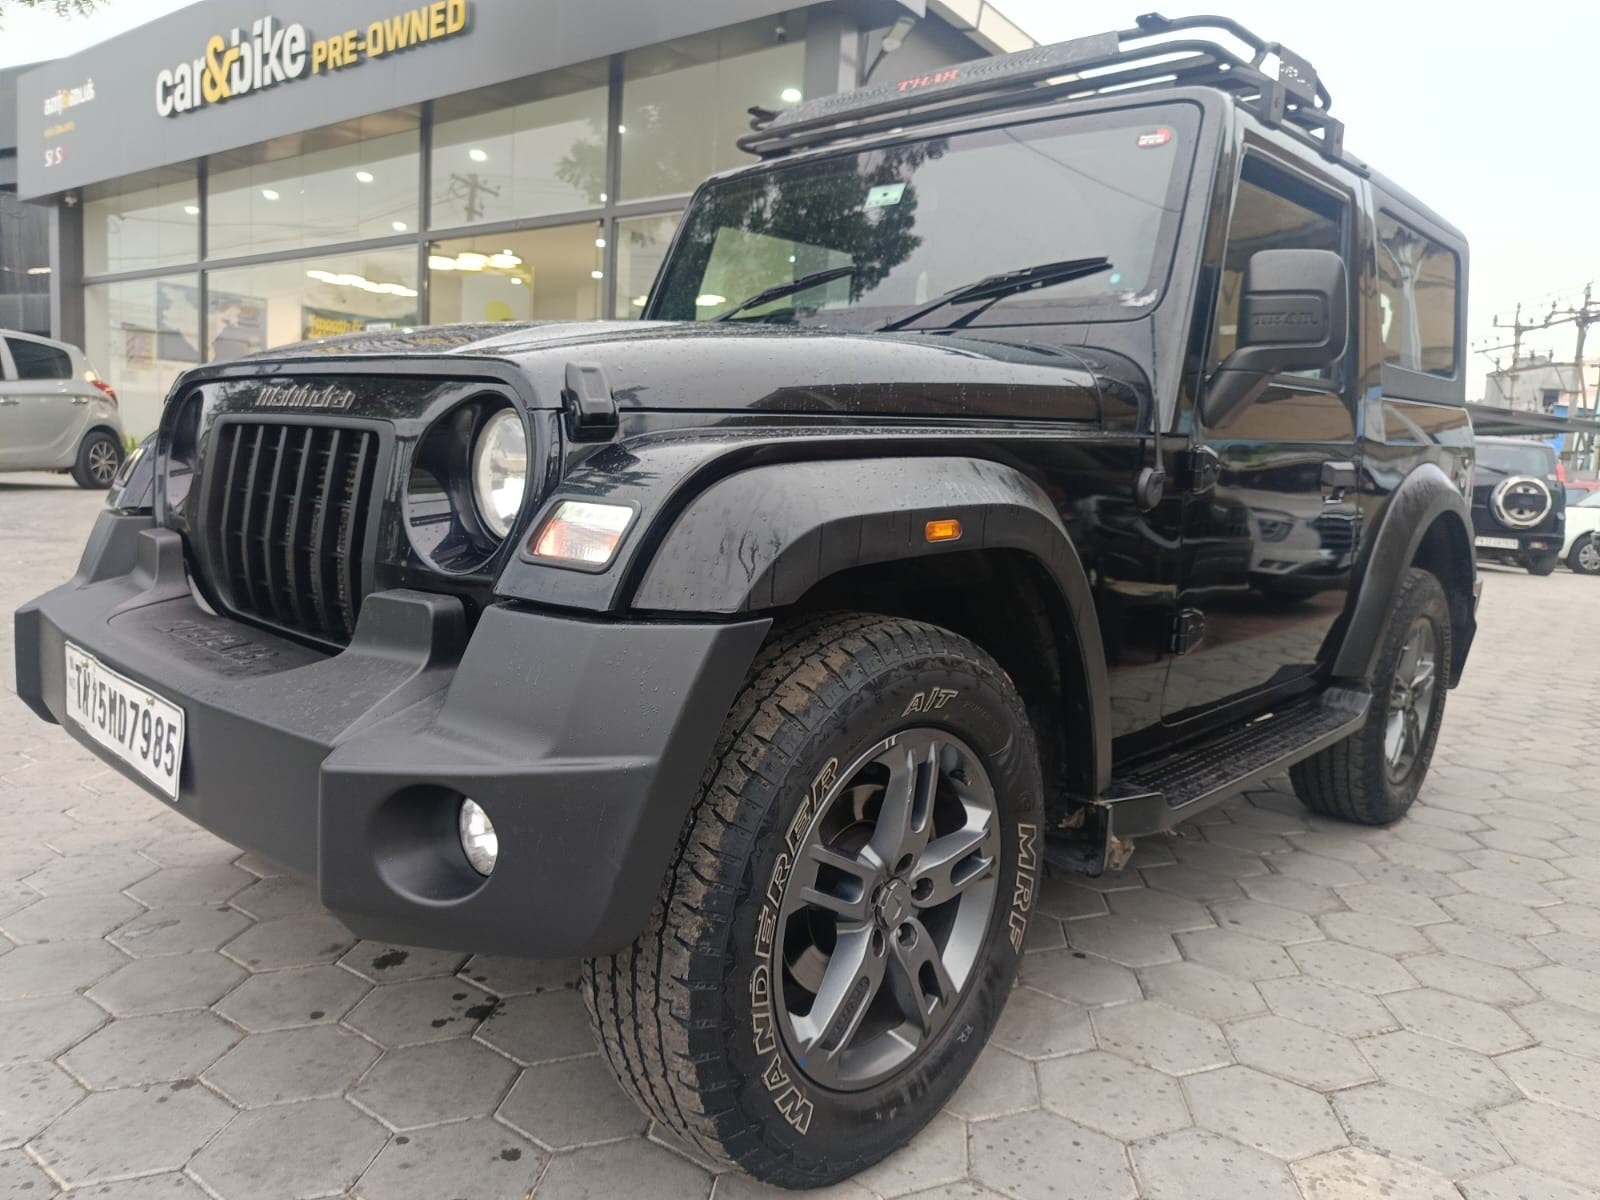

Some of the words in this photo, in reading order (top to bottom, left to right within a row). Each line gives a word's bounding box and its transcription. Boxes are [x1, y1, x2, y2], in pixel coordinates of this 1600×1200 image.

[311, 0, 467, 75] PRE-OWNED
[898, 69, 959, 92] THAR
[902, 686, 960, 718] A/T
[1008, 823, 1037, 954] MRF
[750, 756, 840, 1135] WANDERER
